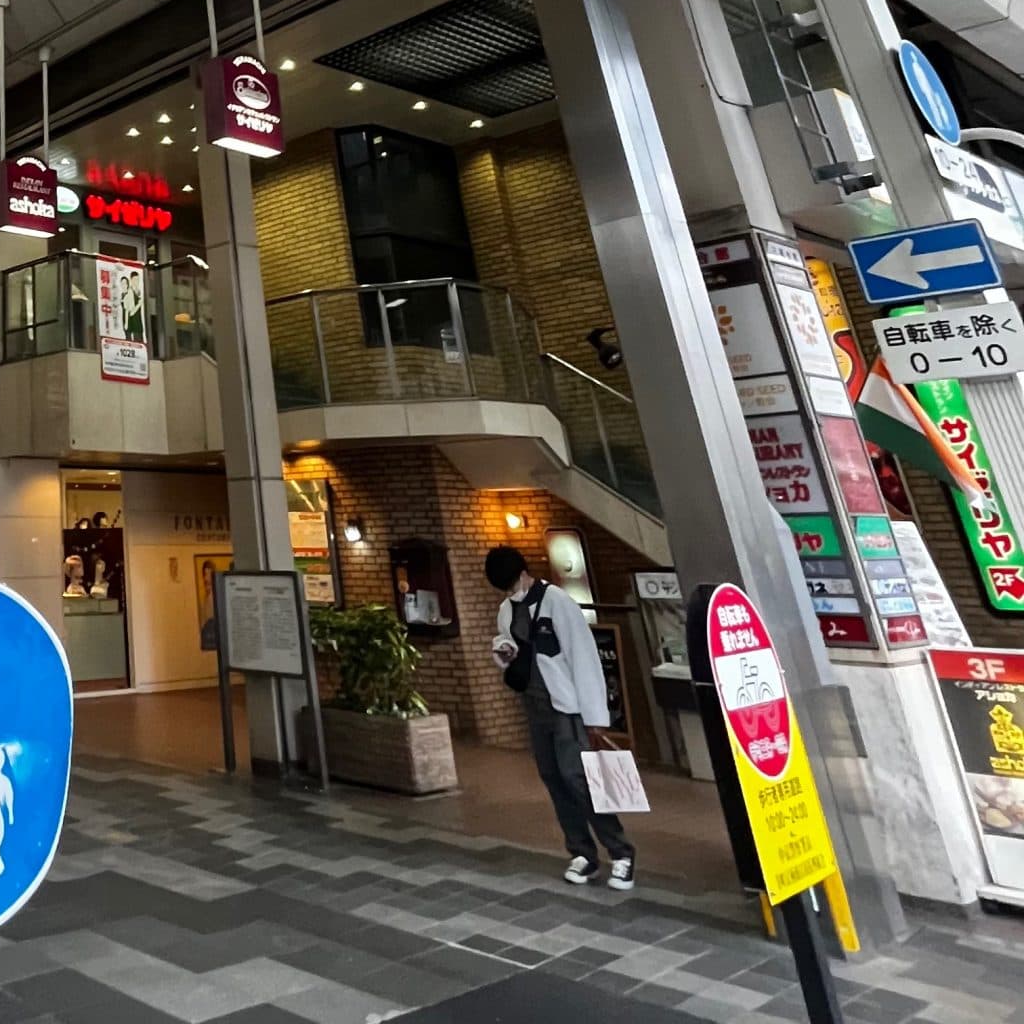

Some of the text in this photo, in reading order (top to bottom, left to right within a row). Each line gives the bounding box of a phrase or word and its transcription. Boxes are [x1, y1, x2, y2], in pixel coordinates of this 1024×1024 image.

[9, 195, 55, 219] ashoka
[883, 314, 1018, 348] 自転車を除く
[993, 572, 1016, 586] 2F
[967, 657, 1005, 680] 3F
